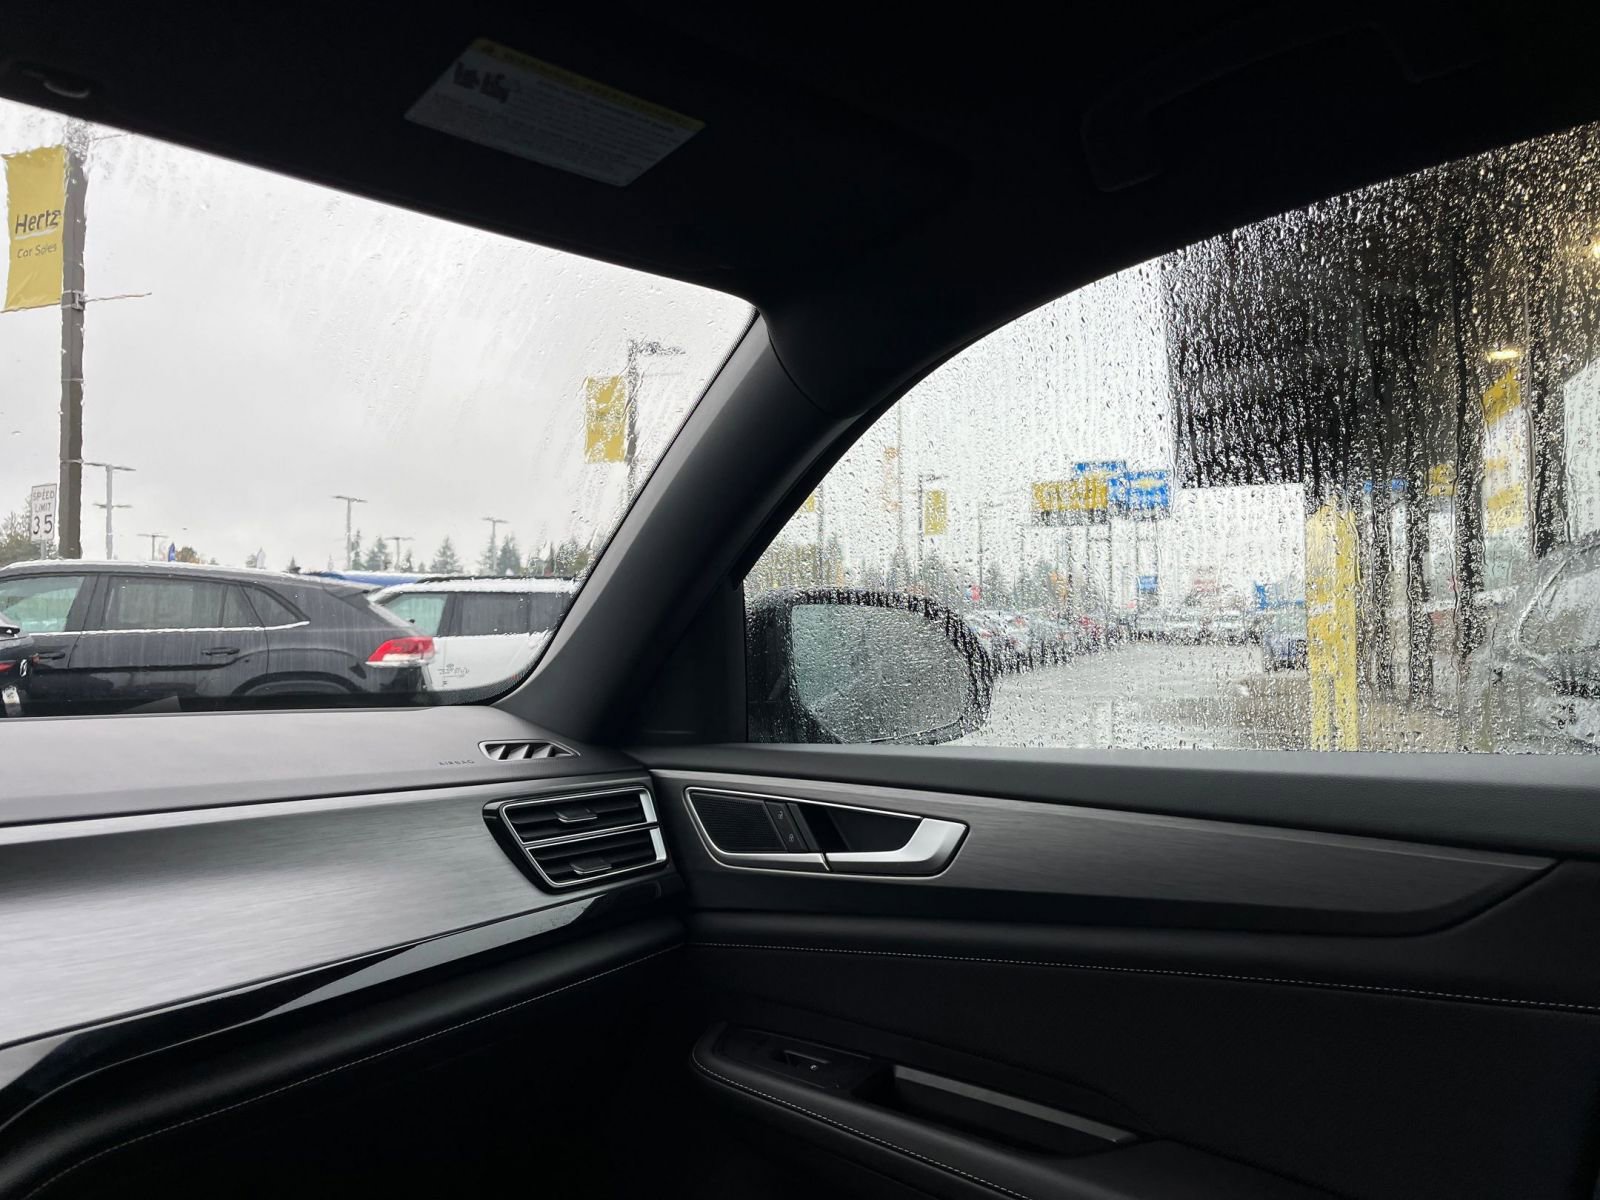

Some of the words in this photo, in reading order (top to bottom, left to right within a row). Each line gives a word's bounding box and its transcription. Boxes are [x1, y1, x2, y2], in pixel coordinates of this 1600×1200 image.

[15, 209, 61, 234] Hertz
[17, 248, 33, 258] Car
[32, 490, 55, 500] SPEED
[35, 502, 52, 513] LIMIT
[33, 514, 53, 534] 35
